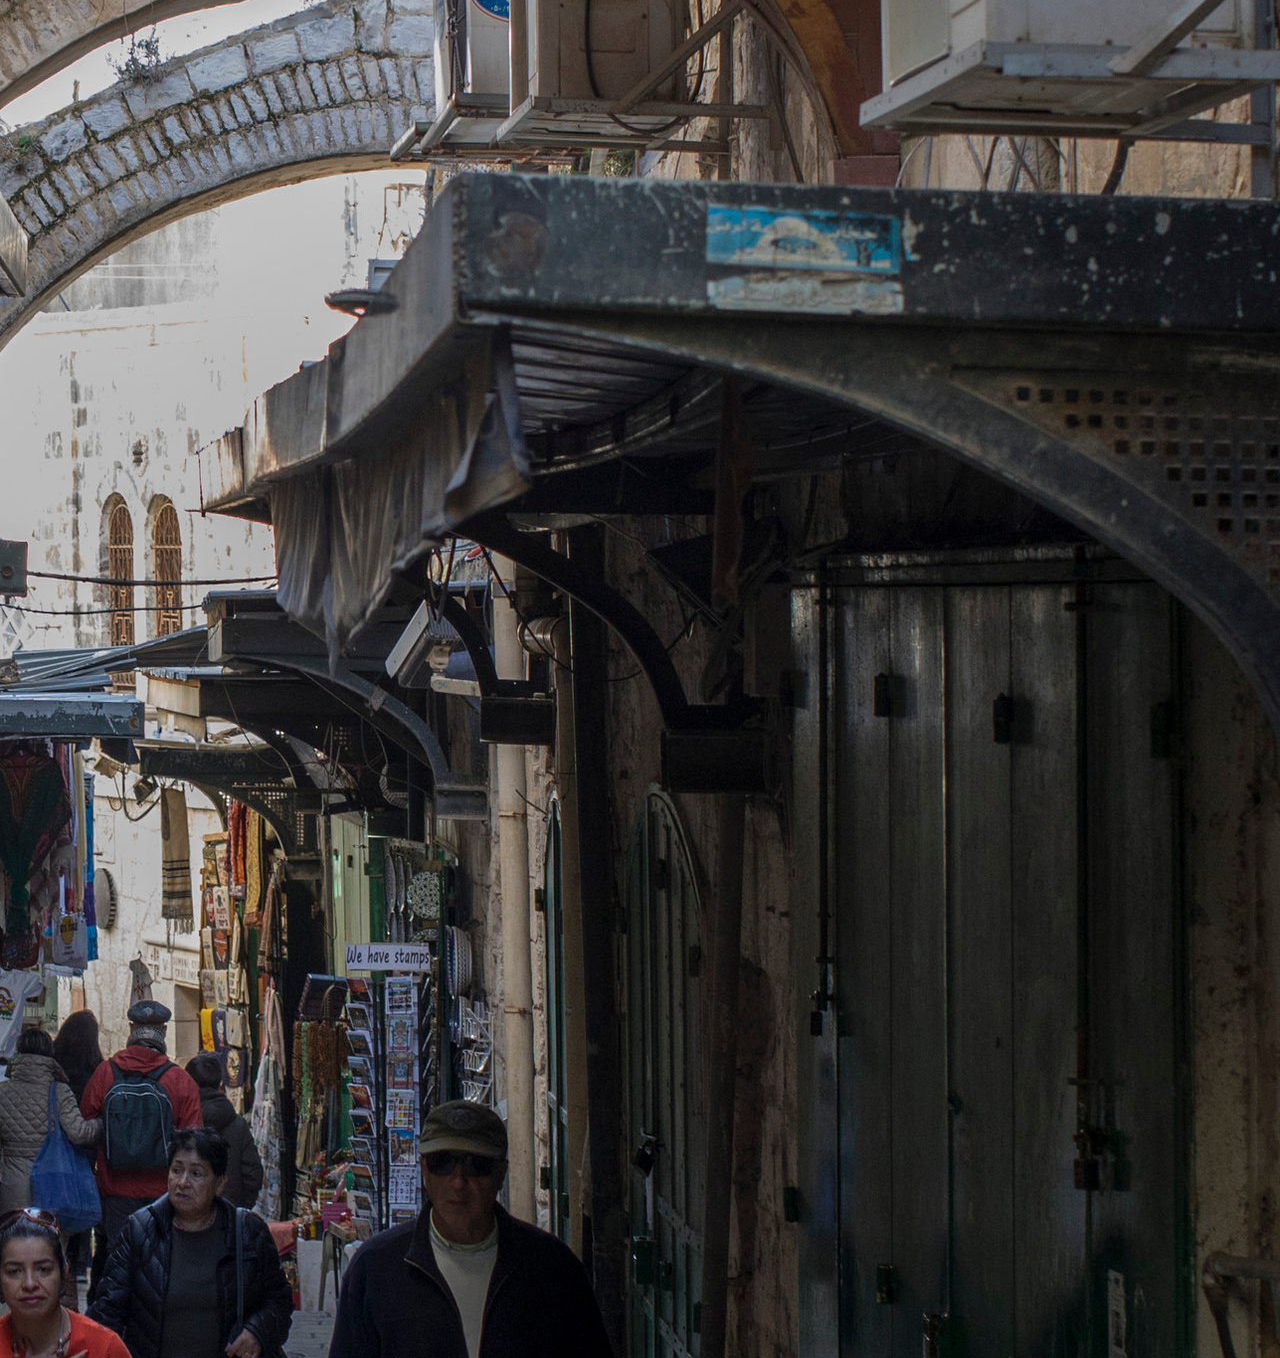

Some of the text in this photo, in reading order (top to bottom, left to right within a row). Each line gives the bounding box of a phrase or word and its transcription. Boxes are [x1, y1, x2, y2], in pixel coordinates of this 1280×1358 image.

[347, 945, 429, 968] We have stamps
